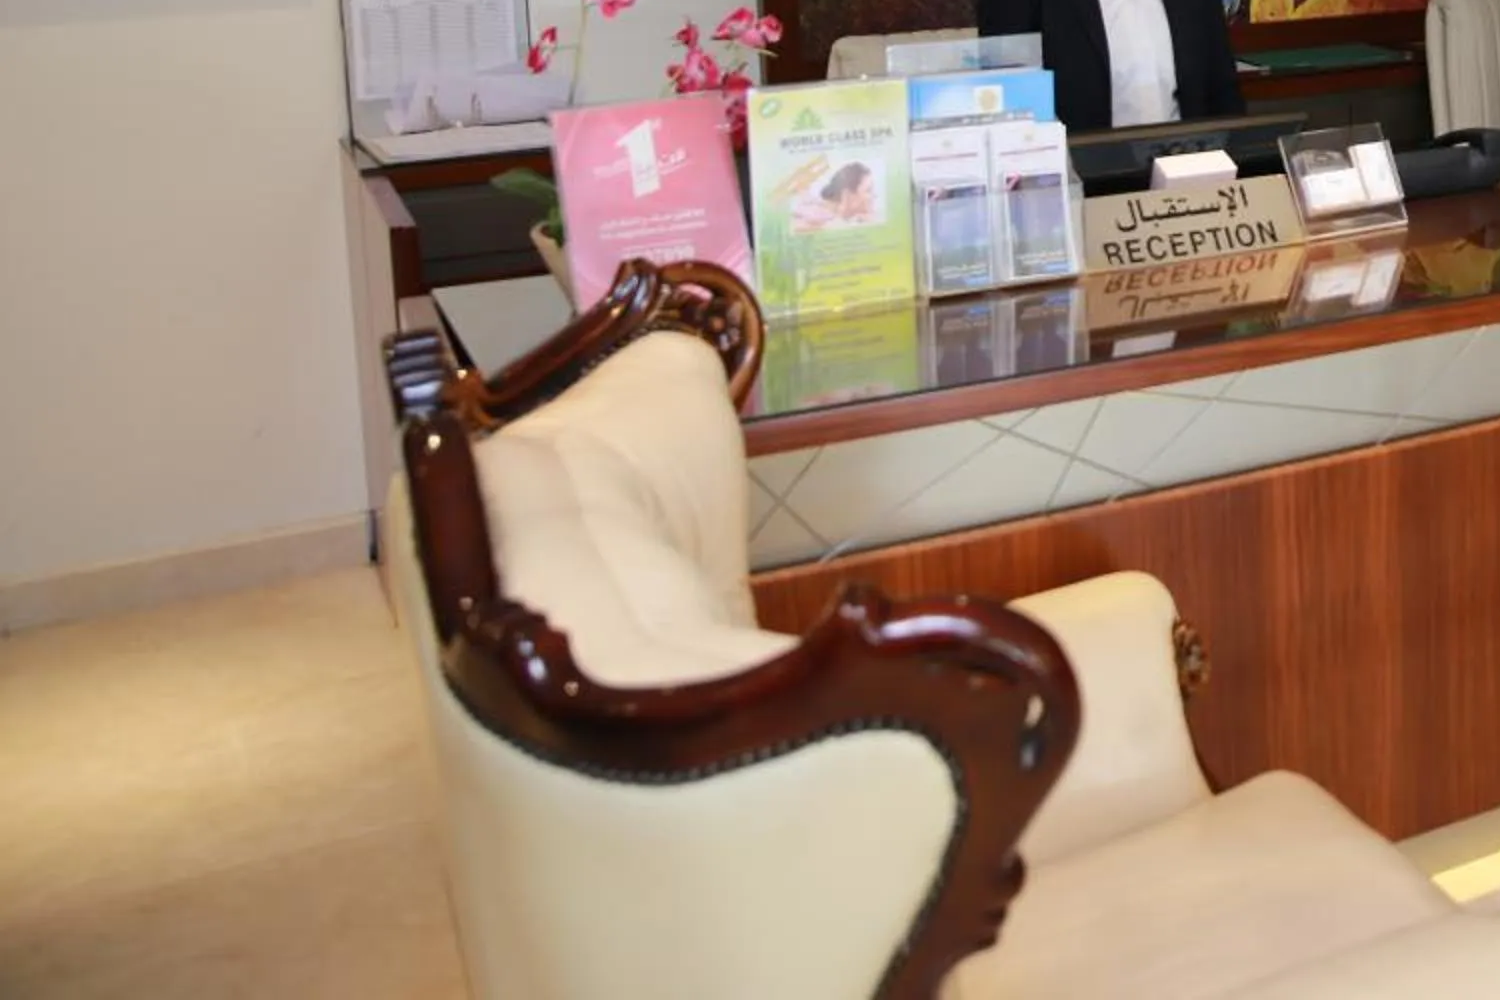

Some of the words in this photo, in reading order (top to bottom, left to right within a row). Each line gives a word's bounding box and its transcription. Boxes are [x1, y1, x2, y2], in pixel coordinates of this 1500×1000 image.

[828, 129, 866, 144] CLASS
[870, 125, 895, 139] SPA
[1103, 220, 1279, 265] RECEPTION
